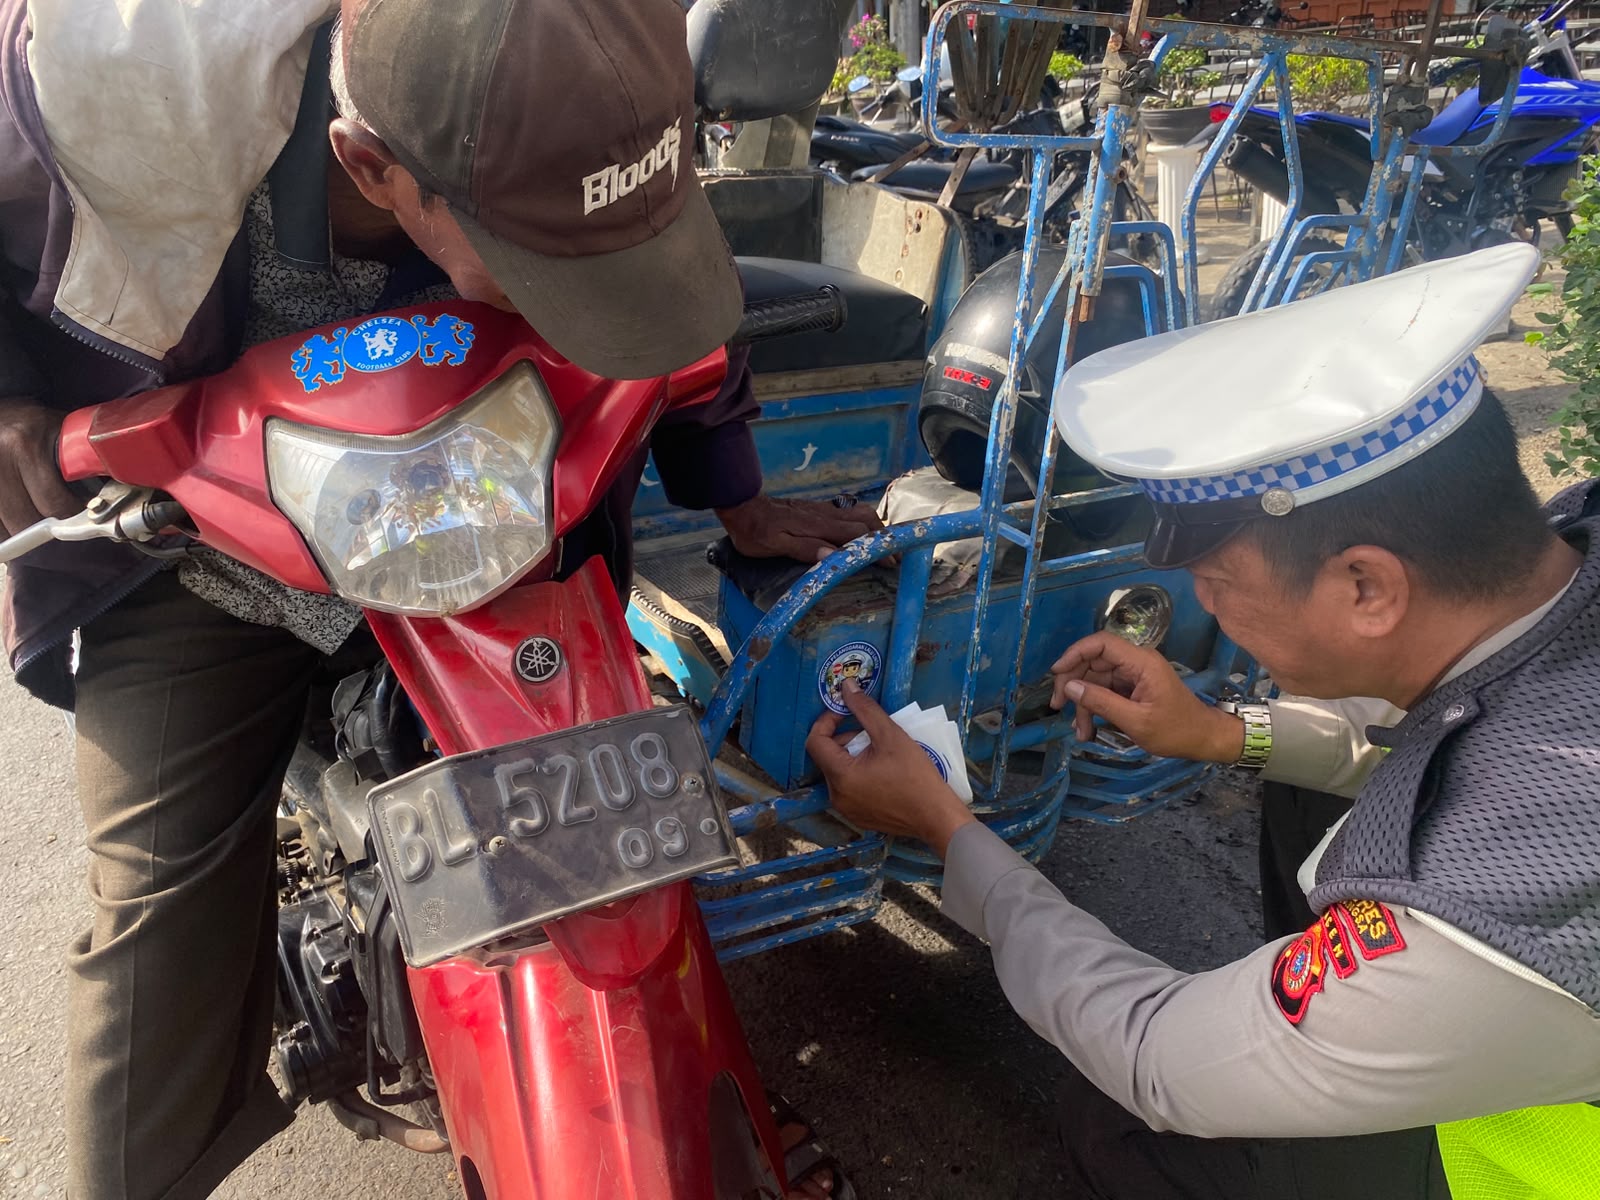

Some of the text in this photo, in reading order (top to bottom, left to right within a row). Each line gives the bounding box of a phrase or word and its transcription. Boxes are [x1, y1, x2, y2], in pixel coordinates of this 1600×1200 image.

[352, 318, 402, 336] CHELSEA
[357, 351, 411, 370] FOOTBALL CLUB
[385, 788, 478, 882] BL
[495, 733, 680, 837] 5208
[1355, 900, 1388, 940] RES
